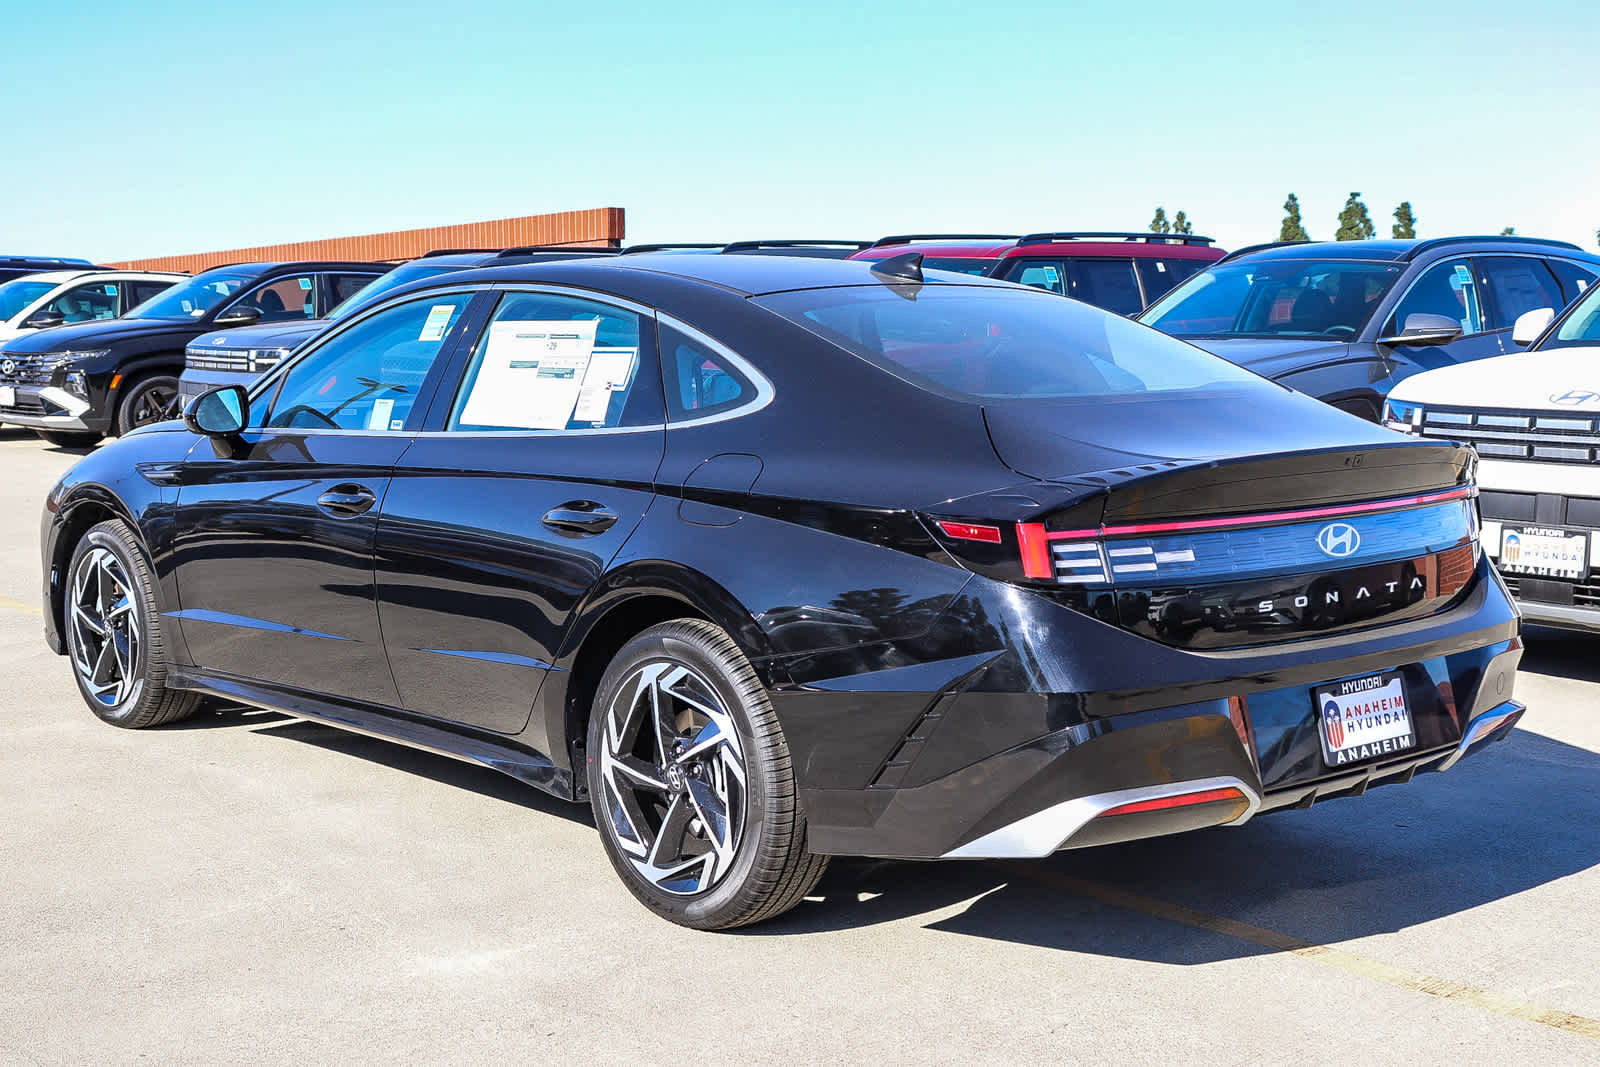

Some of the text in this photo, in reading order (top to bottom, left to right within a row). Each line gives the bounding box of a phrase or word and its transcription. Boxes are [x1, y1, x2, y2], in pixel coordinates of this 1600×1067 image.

[1523, 527, 1564, 538] HYUNDAI
[1258, 577, 1422, 612] SONATA
[1341, 676, 1382, 694] HYUNDAI
[1345, 696, 1403, 719] ANAHEIM
[1347, 710, 1406, 733] HYUNDAI
[1337, 736, 1410, 764] ANAHEIM
